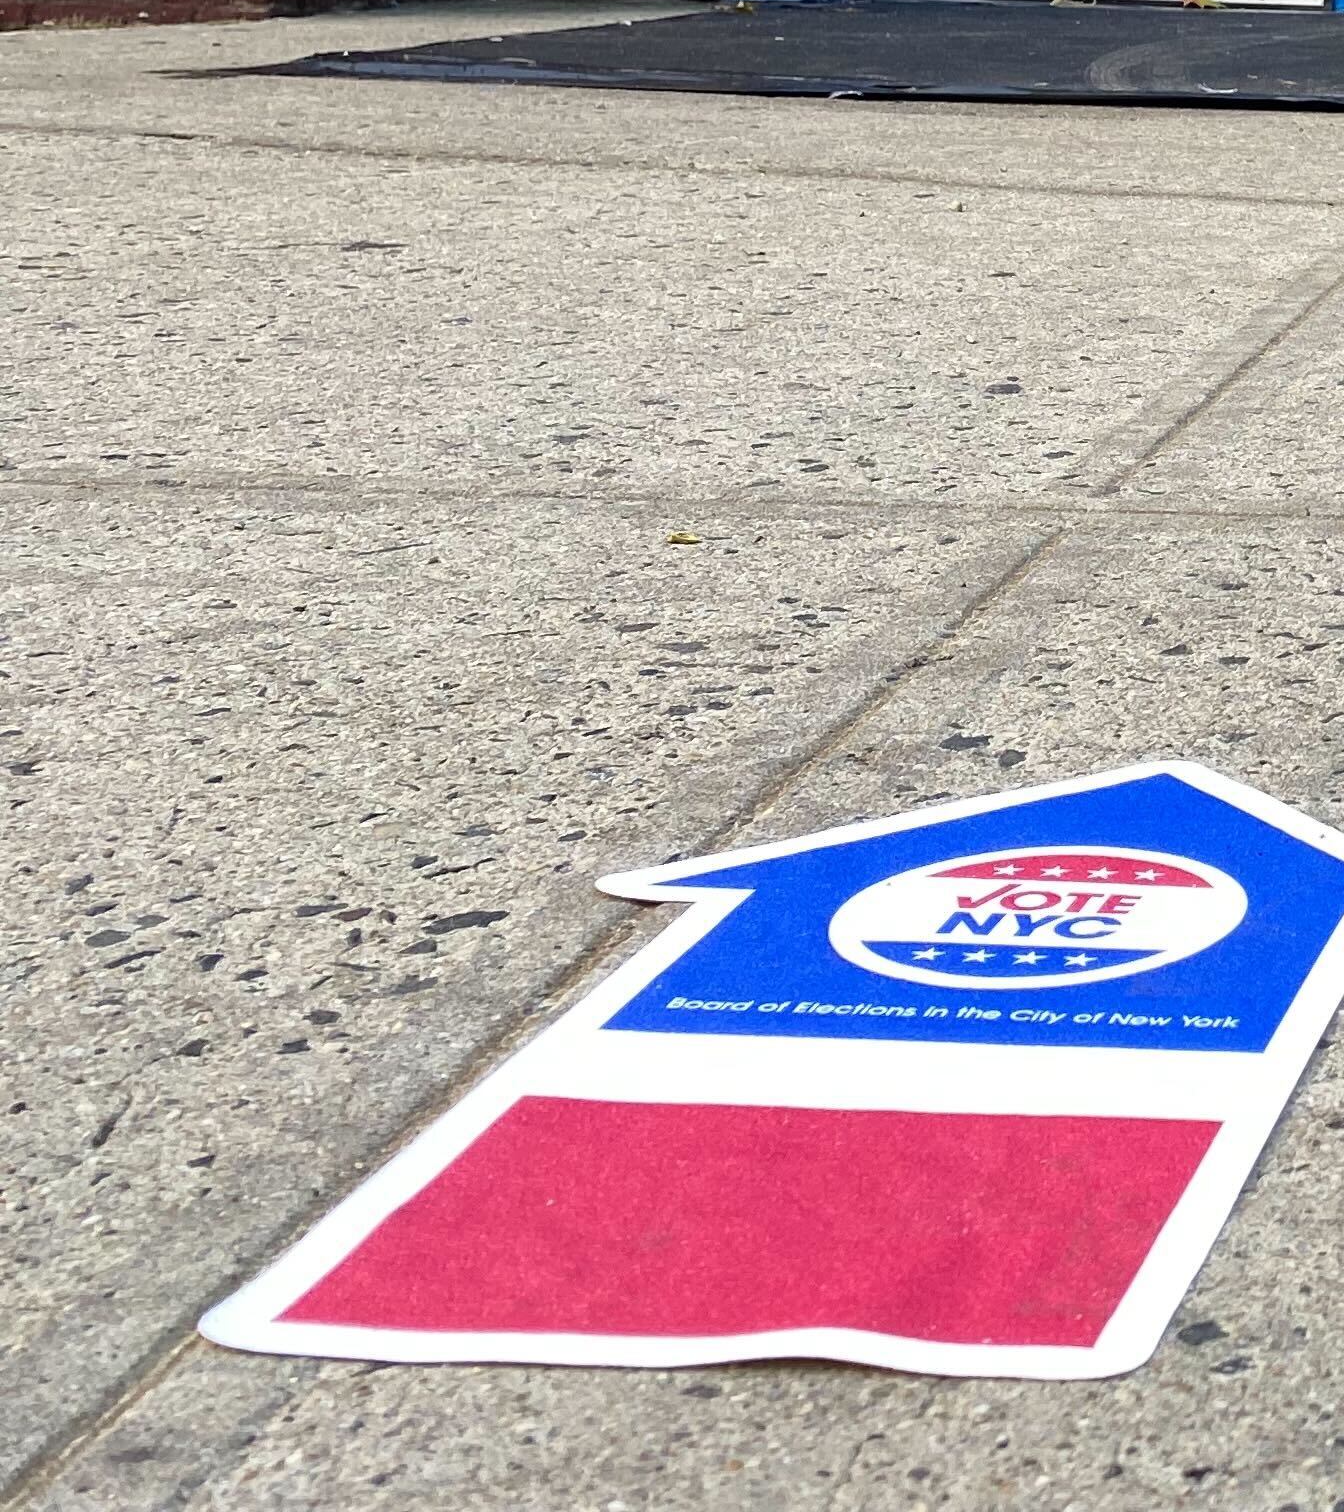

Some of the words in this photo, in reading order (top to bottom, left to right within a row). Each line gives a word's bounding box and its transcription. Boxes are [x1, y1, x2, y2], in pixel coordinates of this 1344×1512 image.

[957, 884, 1143, 915] VOTE
[936, 911, 1123, 940] NYC
[665, 996, 756, 1012] Board
[757, 1000, 788, 1013] of
[793, 1000, 918, 1018] Elections
[923, 1005, 948, 1019] in
[956, 1005, 1002, 1021] the
[1009, 1008, 1069, 1025] City
[1072, 1011, 1104, 1025] of
[1108, 1012, 1174, 1027] New
[1181, 1014, 1241, 1030] York
